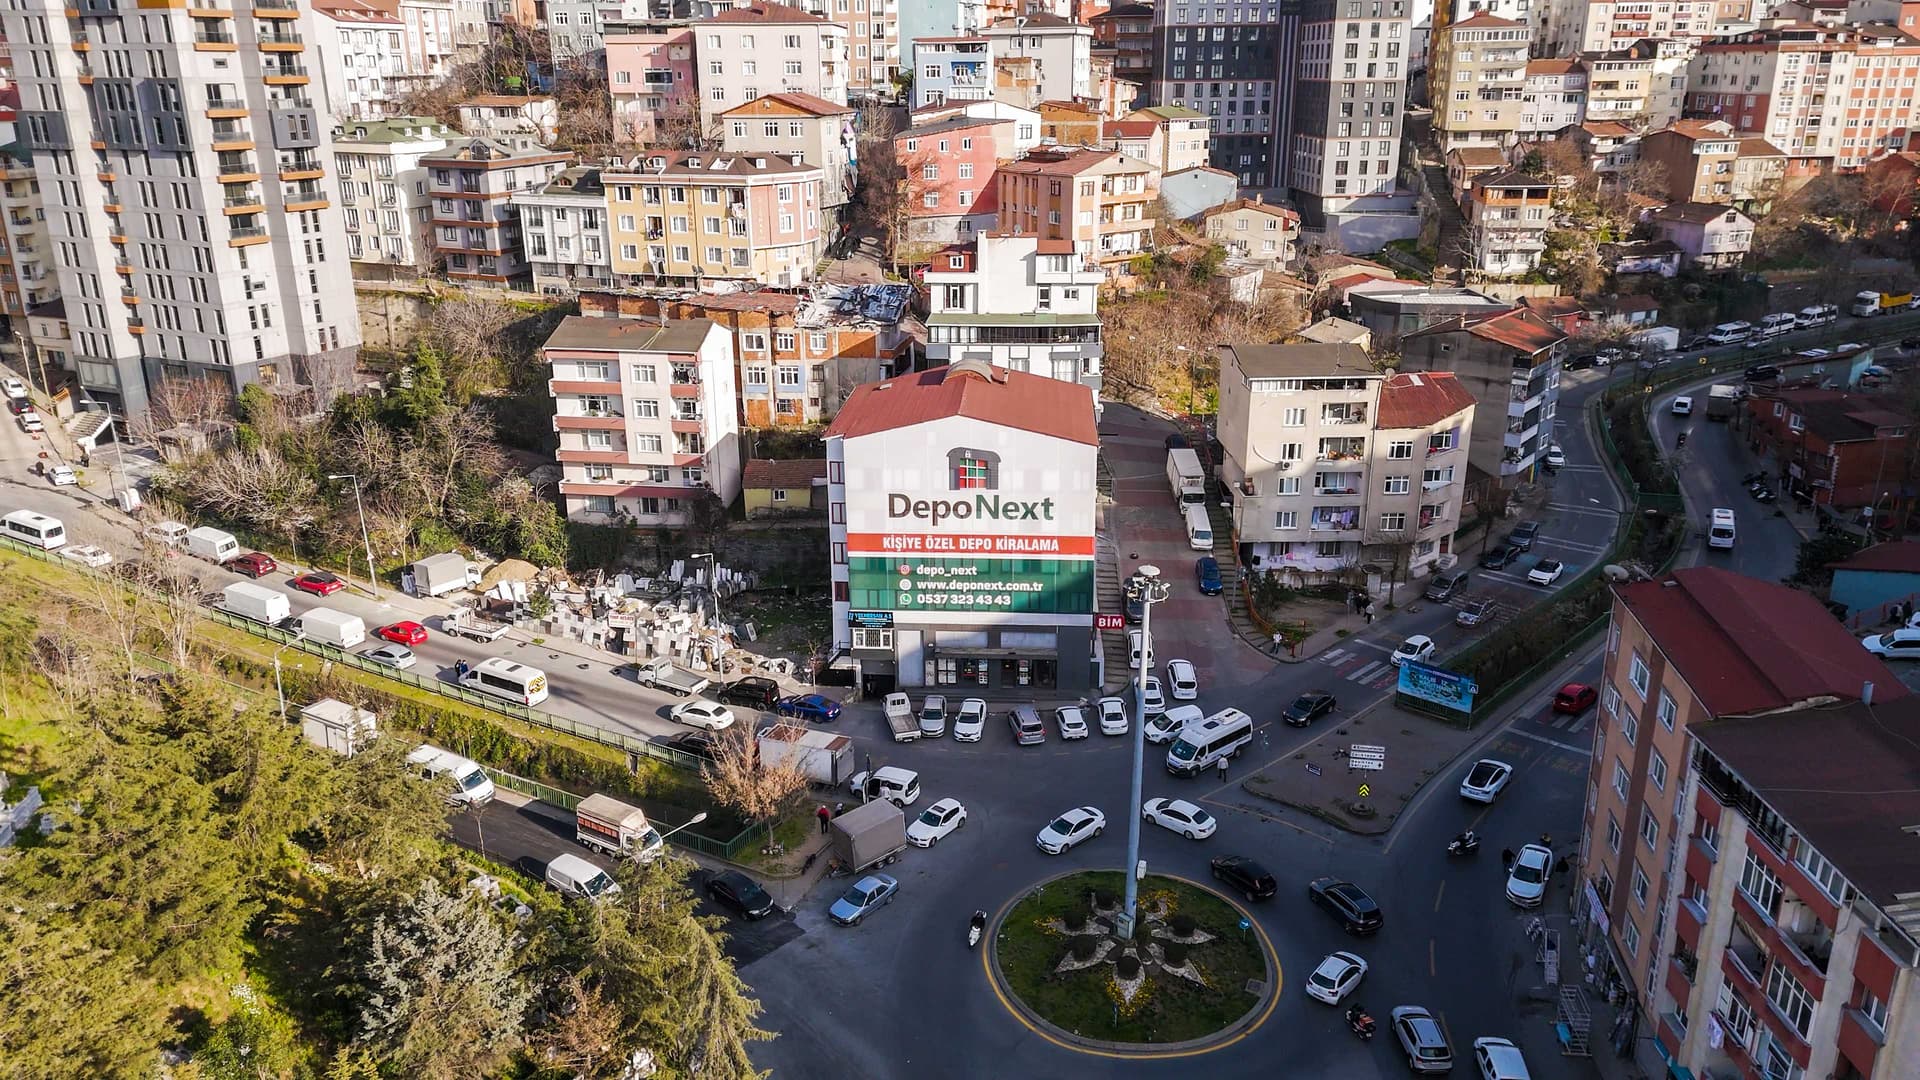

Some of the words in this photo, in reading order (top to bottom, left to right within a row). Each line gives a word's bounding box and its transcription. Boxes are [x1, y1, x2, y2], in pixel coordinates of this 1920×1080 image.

[888, 493, 1054, 526] DepoNext
[883, 534, 921, 551] KİŞİYE
[925, 535, 955, 549] ÖZEL
[959, 537, 992, 550] DEPO
[996, 536, 1059, 551] KİRALAMA
[916, 564, 977, 577] depo_next
[916, 579, 1043, 592] www.deponext.com.tr
[916, 594, 948, 604] 0537
[950, 595, 974, 604] 323
[976, 595, 993, 605] 43
[994, 595, 1011, 605] 43
[1098, 616, 1122, 627] BİM
